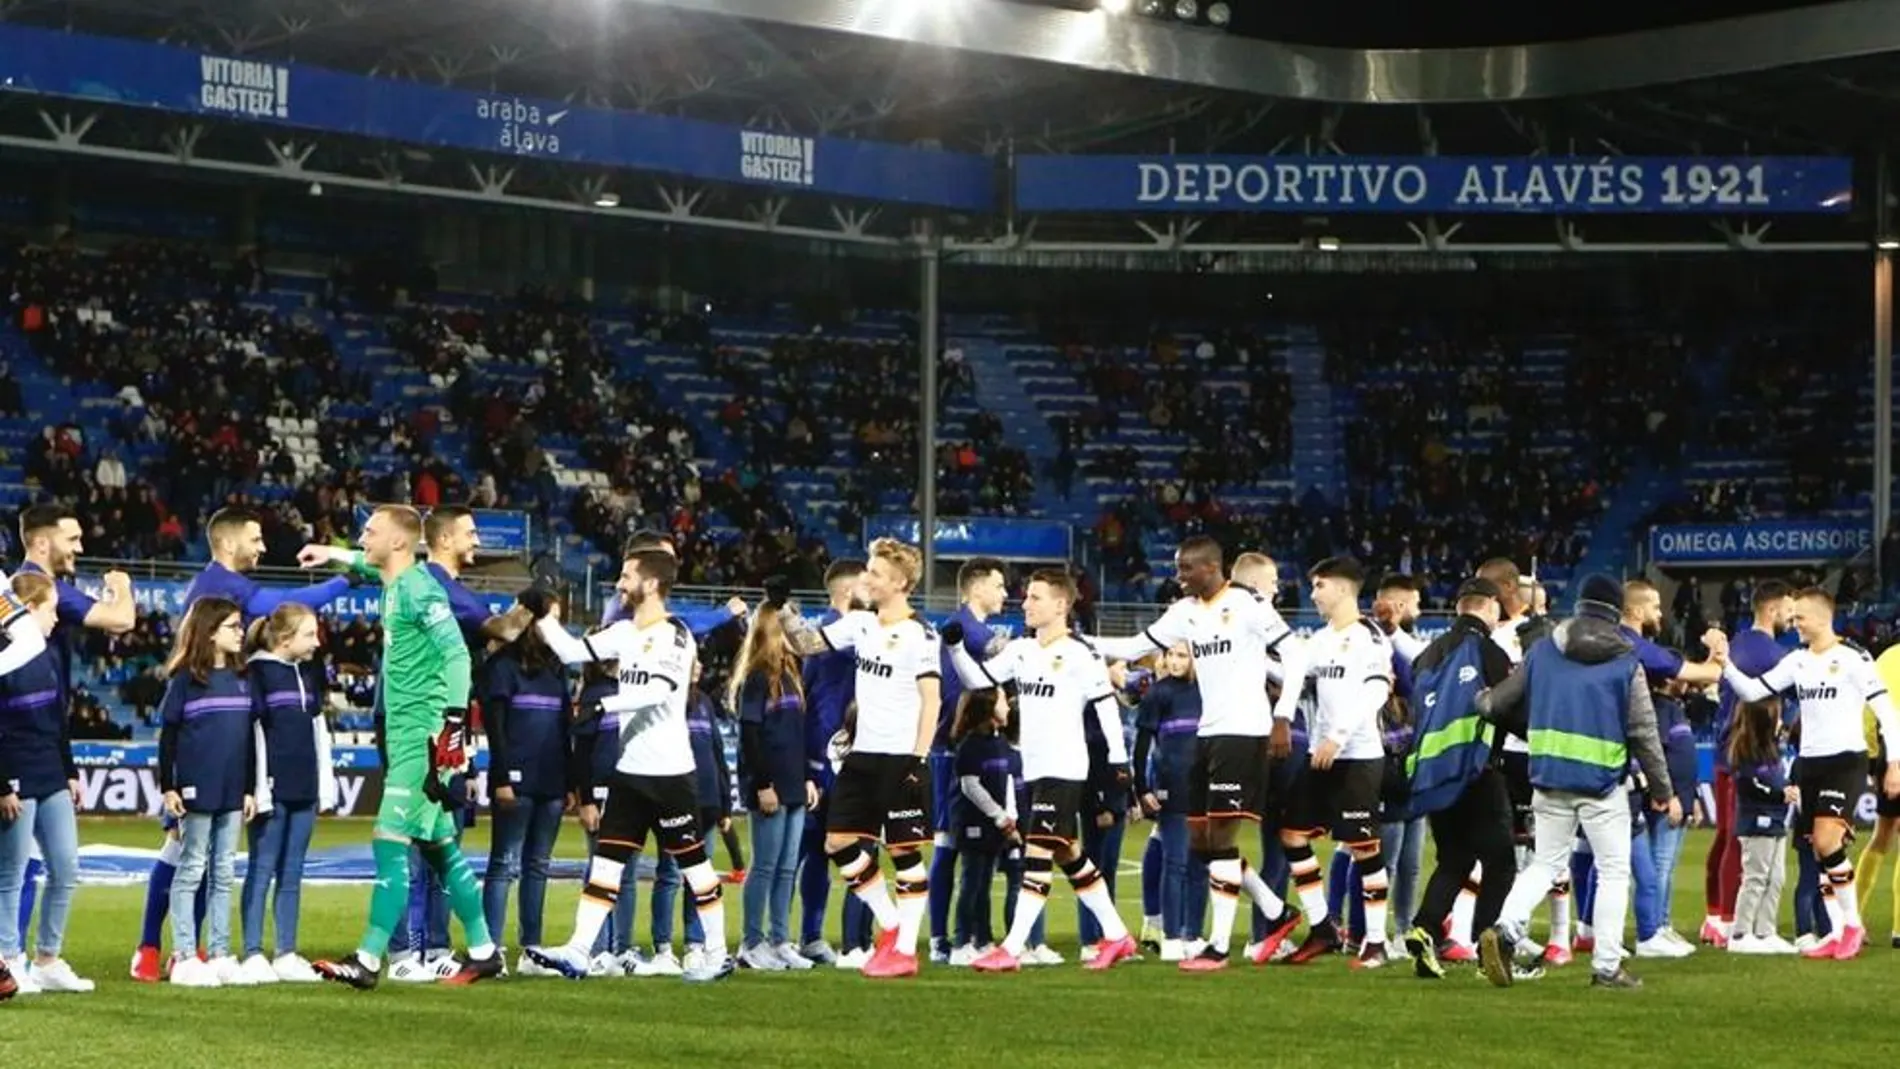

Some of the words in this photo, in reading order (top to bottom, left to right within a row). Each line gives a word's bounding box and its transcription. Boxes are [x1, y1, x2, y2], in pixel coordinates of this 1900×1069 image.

[201, 54, 274, 90] VITORIA
[477, 98, 540, 125] araba
[501, 122, 560, 154] álava
[741, 130, 802, 158] VITORIA
[1137, 163, 1427, 204] DEPORTIVO
[1456, 156, 1644, 204] ALAVÉS
[1661, 164, 1770, 204] 1921
[1659, 531, 1736, 553] OMEGA
[1192, 635, 1232, 659] bwin
